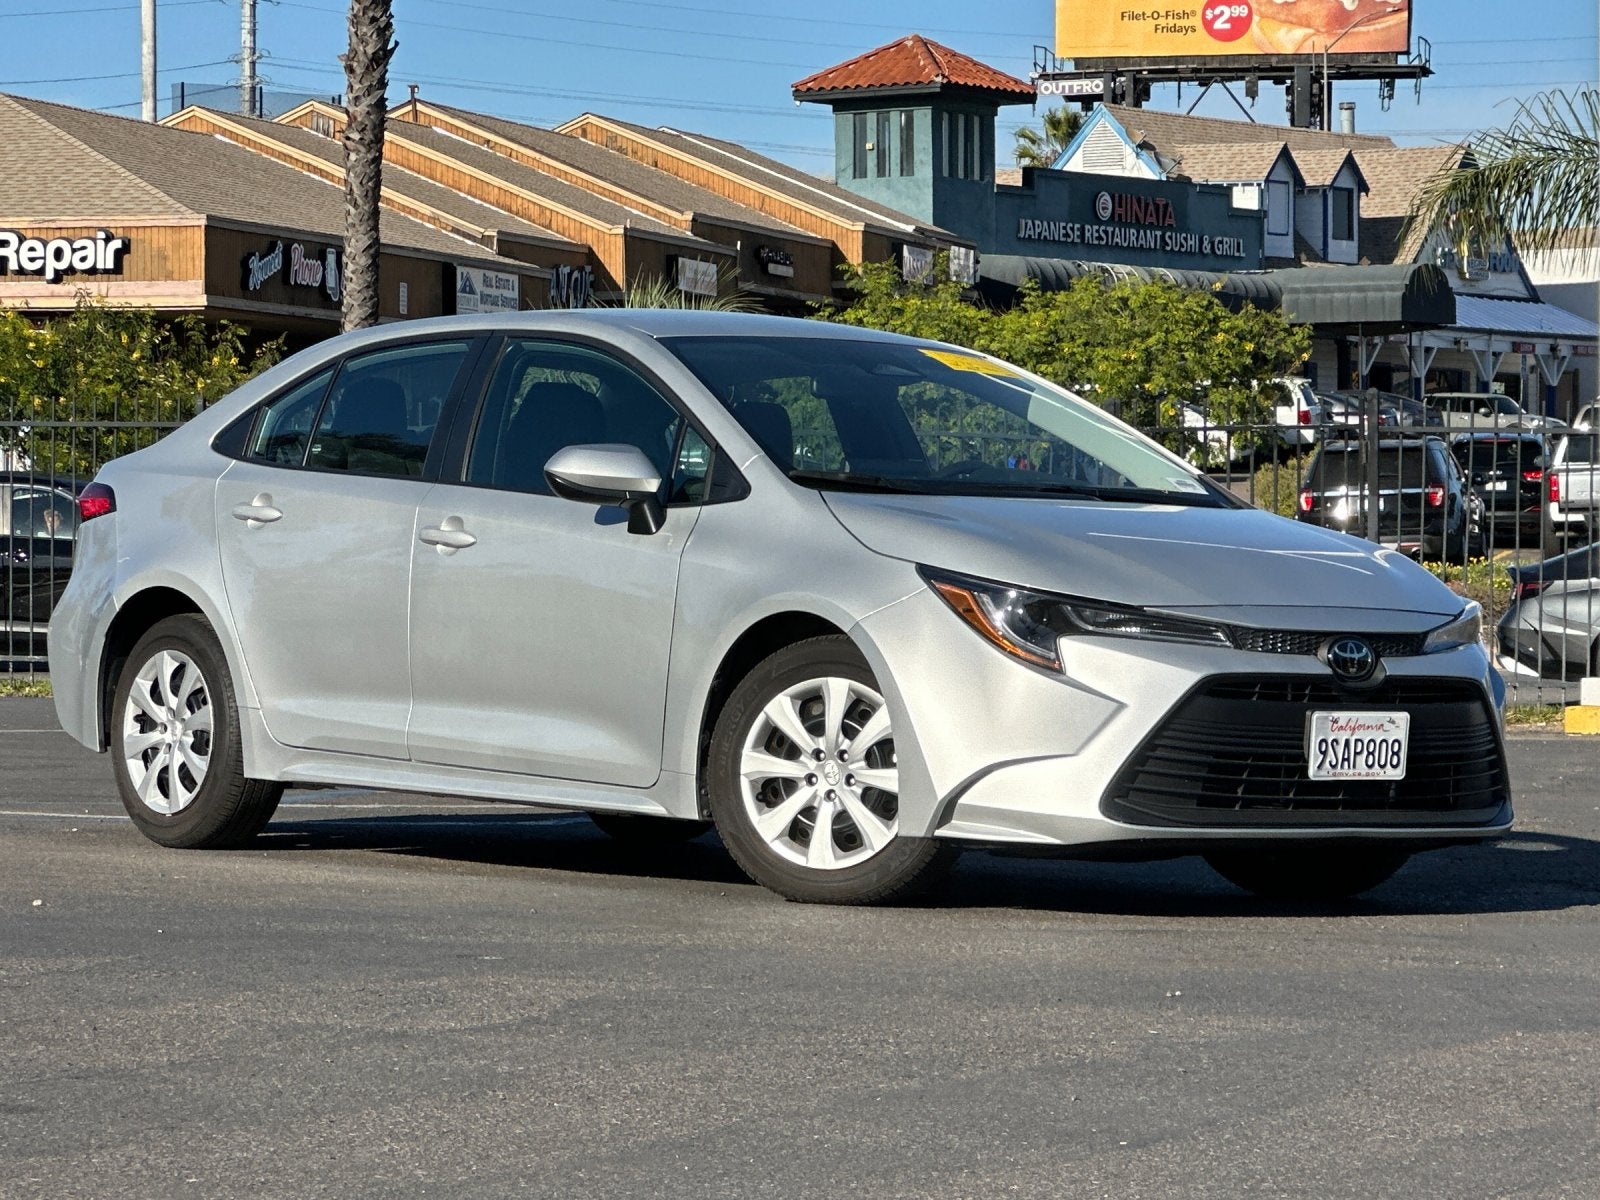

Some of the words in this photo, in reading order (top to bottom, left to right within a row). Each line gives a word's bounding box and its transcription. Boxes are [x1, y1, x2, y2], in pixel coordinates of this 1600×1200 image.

[1154, 23, 1197, 36] Fridays
[1040, 79, 1104, 95] OUTFRO
[1114, 193, 1176, 228] HINATA
[1018, 218, 1081, 243] JAPANESE
[1084, 224, 1162, 249] RESTAURANT
[1165, 231, 1199, 253] SUSHI
[1202, 235, 1211, 254] &
[1214, 236, 1246, 257] GRILL
[0, 231, 123, 280] Repair
[290, 243, 323, 287] Phone
[1330, 717, 1391, 737] California
[1316, 737, 1402, 770] 9SAP808
